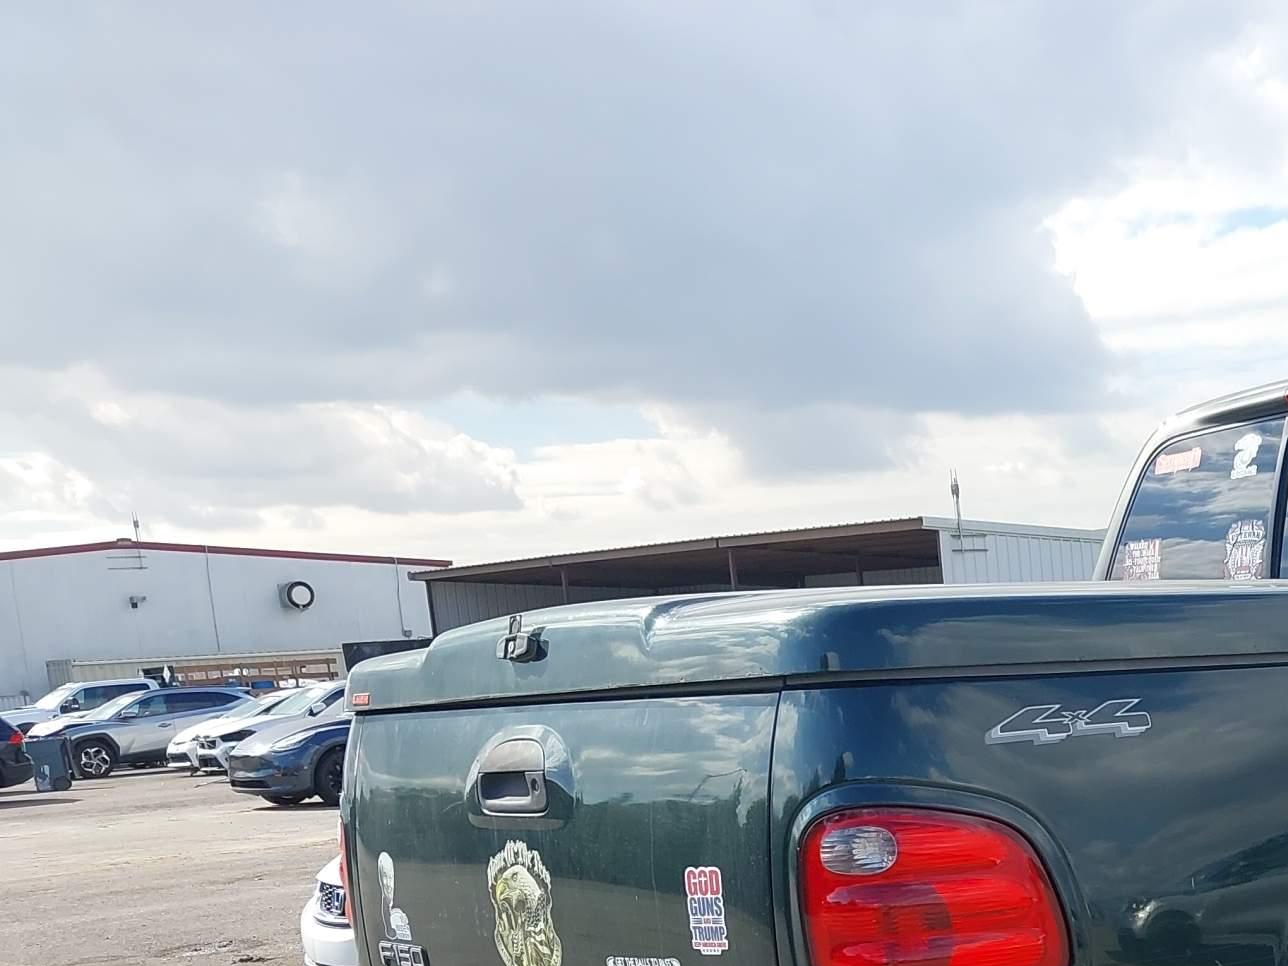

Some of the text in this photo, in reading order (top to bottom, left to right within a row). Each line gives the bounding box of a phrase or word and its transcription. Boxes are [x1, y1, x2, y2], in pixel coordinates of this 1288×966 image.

[686, 869, 721, 897] GOD
[689, 896, 723, 917] GUNS
[691, 925, 725, 941] TRUMP
[625, 958, 635, 966] THE
